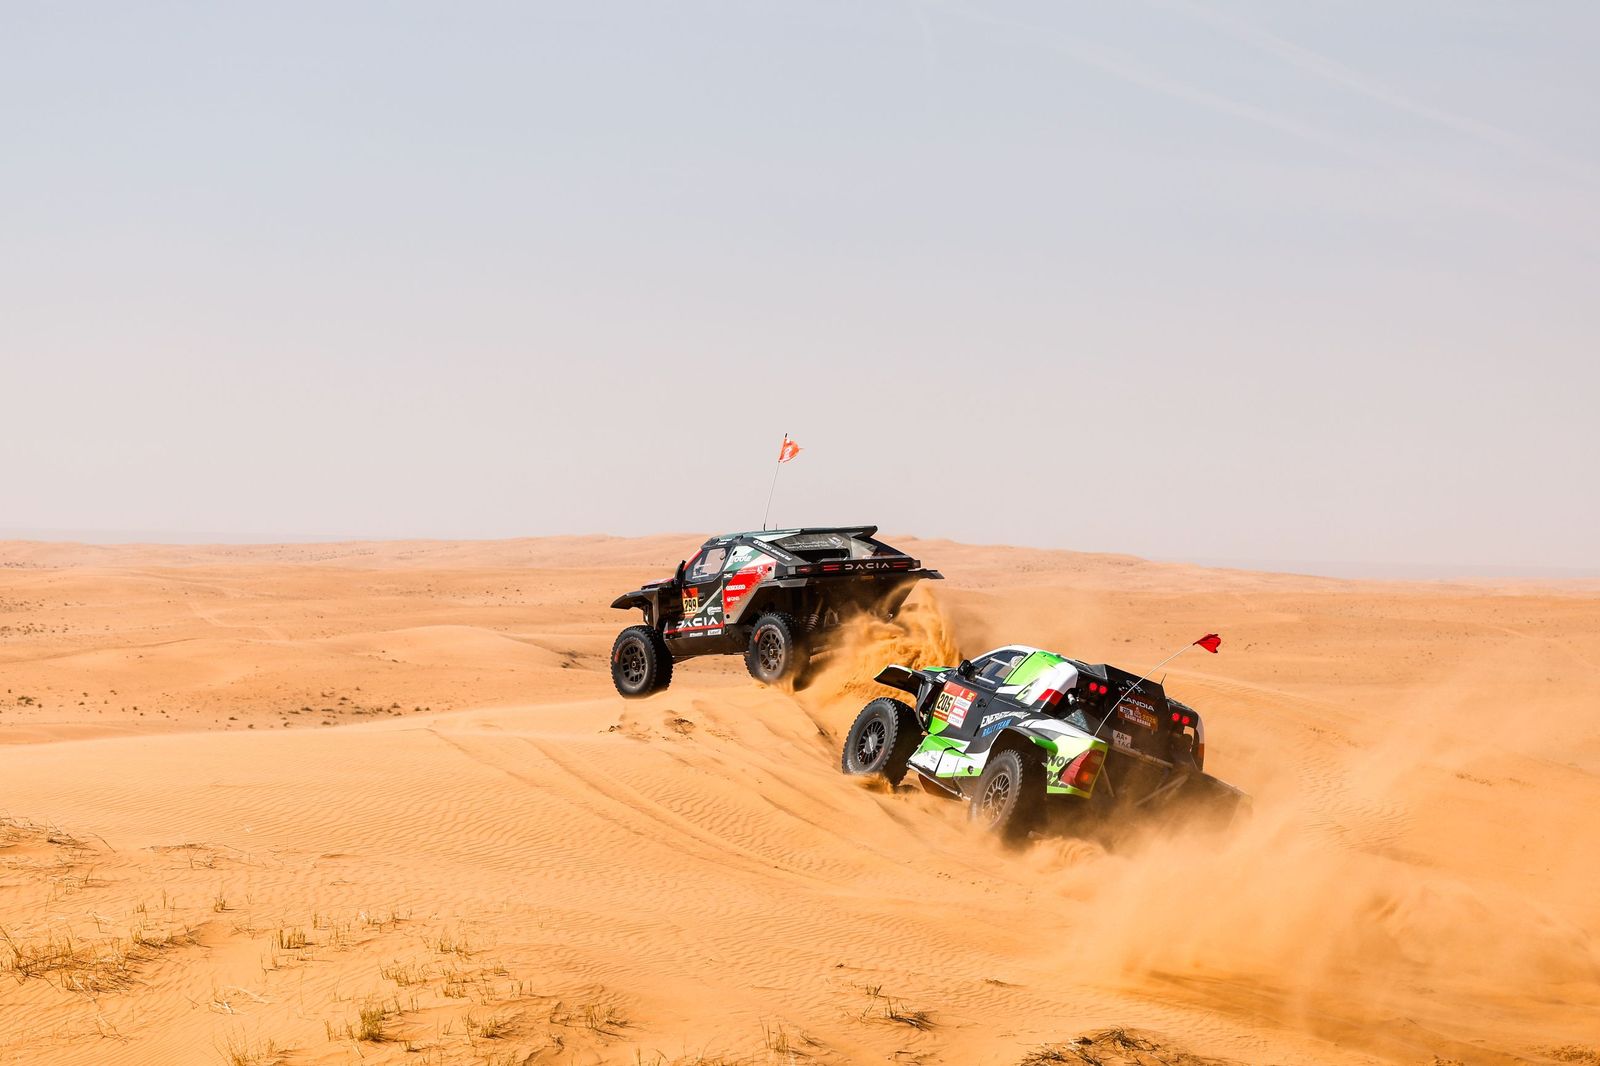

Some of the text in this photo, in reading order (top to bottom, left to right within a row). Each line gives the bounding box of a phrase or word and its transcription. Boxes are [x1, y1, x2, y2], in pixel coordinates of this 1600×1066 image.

[844, 562, 890, 570] DACIA
[684, 598, 697, 612] 299
[676, 617, 719, 629] DACIA
[936, 693, 954, 712] 205
